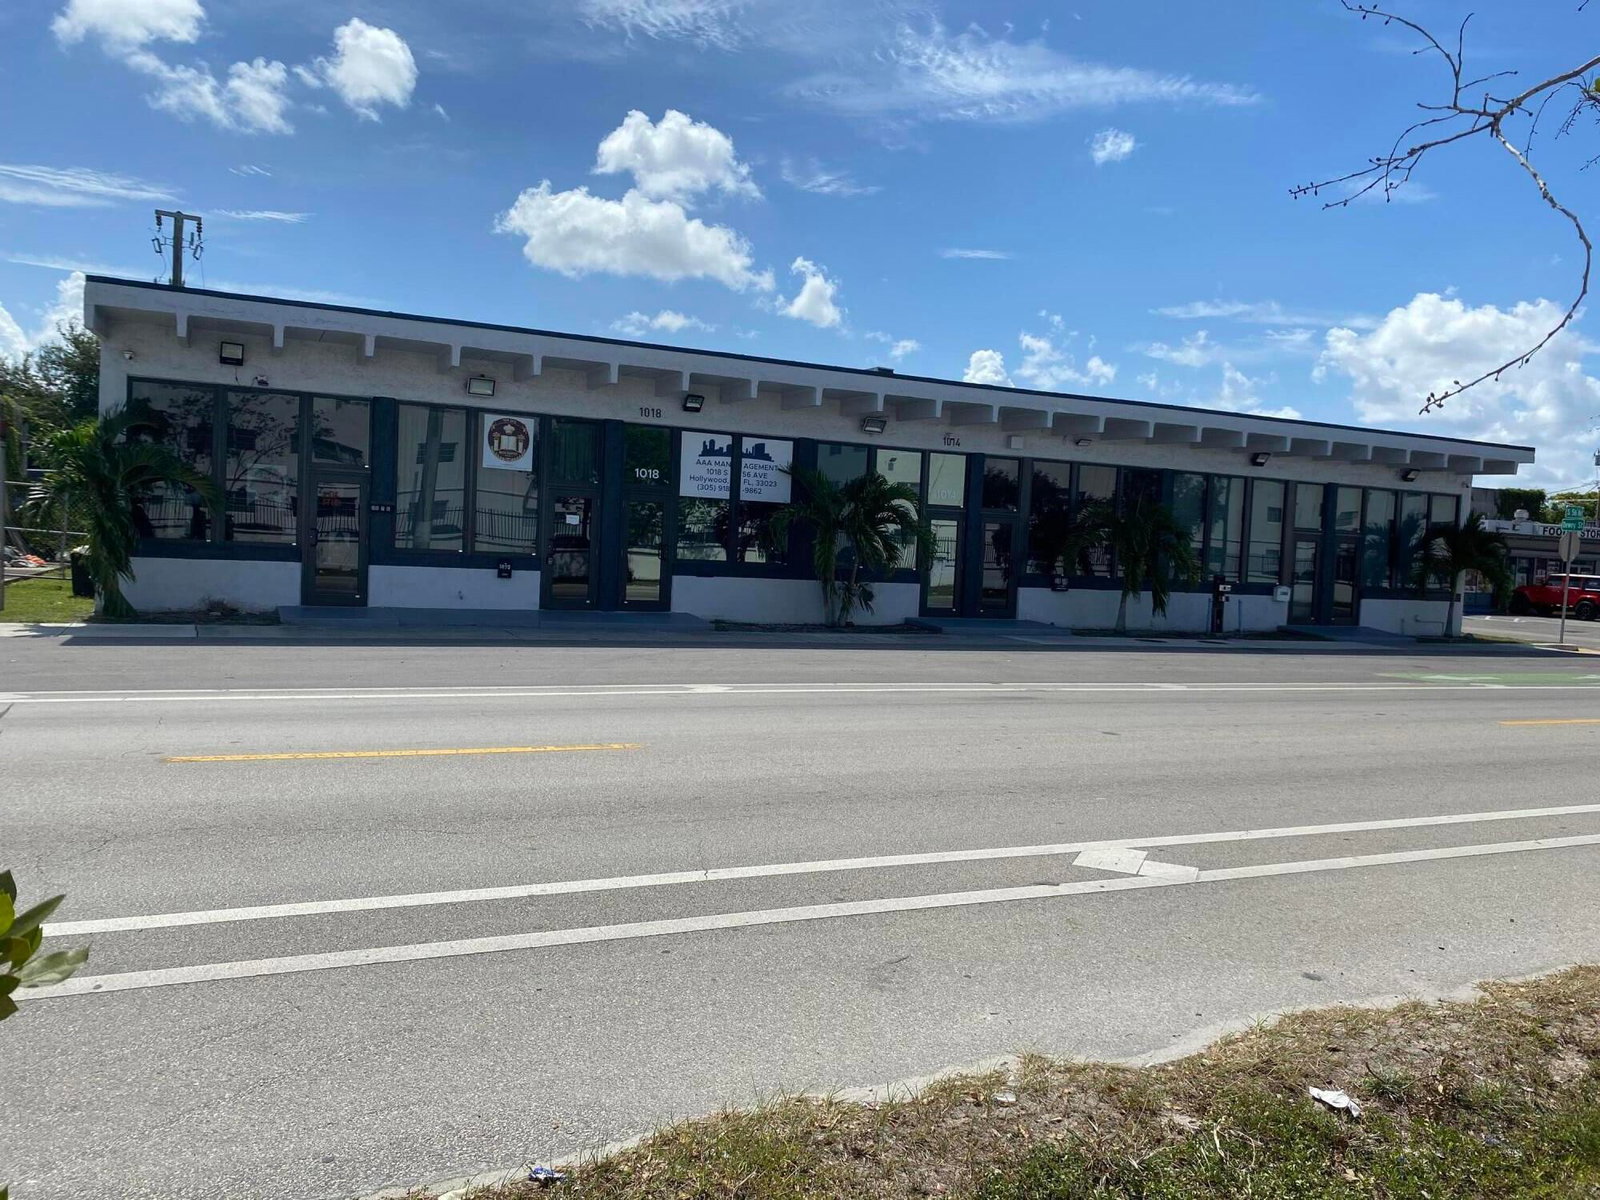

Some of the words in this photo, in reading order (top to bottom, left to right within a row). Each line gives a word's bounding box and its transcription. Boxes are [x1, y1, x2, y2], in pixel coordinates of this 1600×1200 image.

[640, 407, 662, 418] 1018
[696, 459, 712, 467] AAA
[635, 468, 660, 480] 1018
[706, 468, 722, 476] 1018
[756, 480, 778, 488] 33023
[696, 484, 717, 493] (305)
